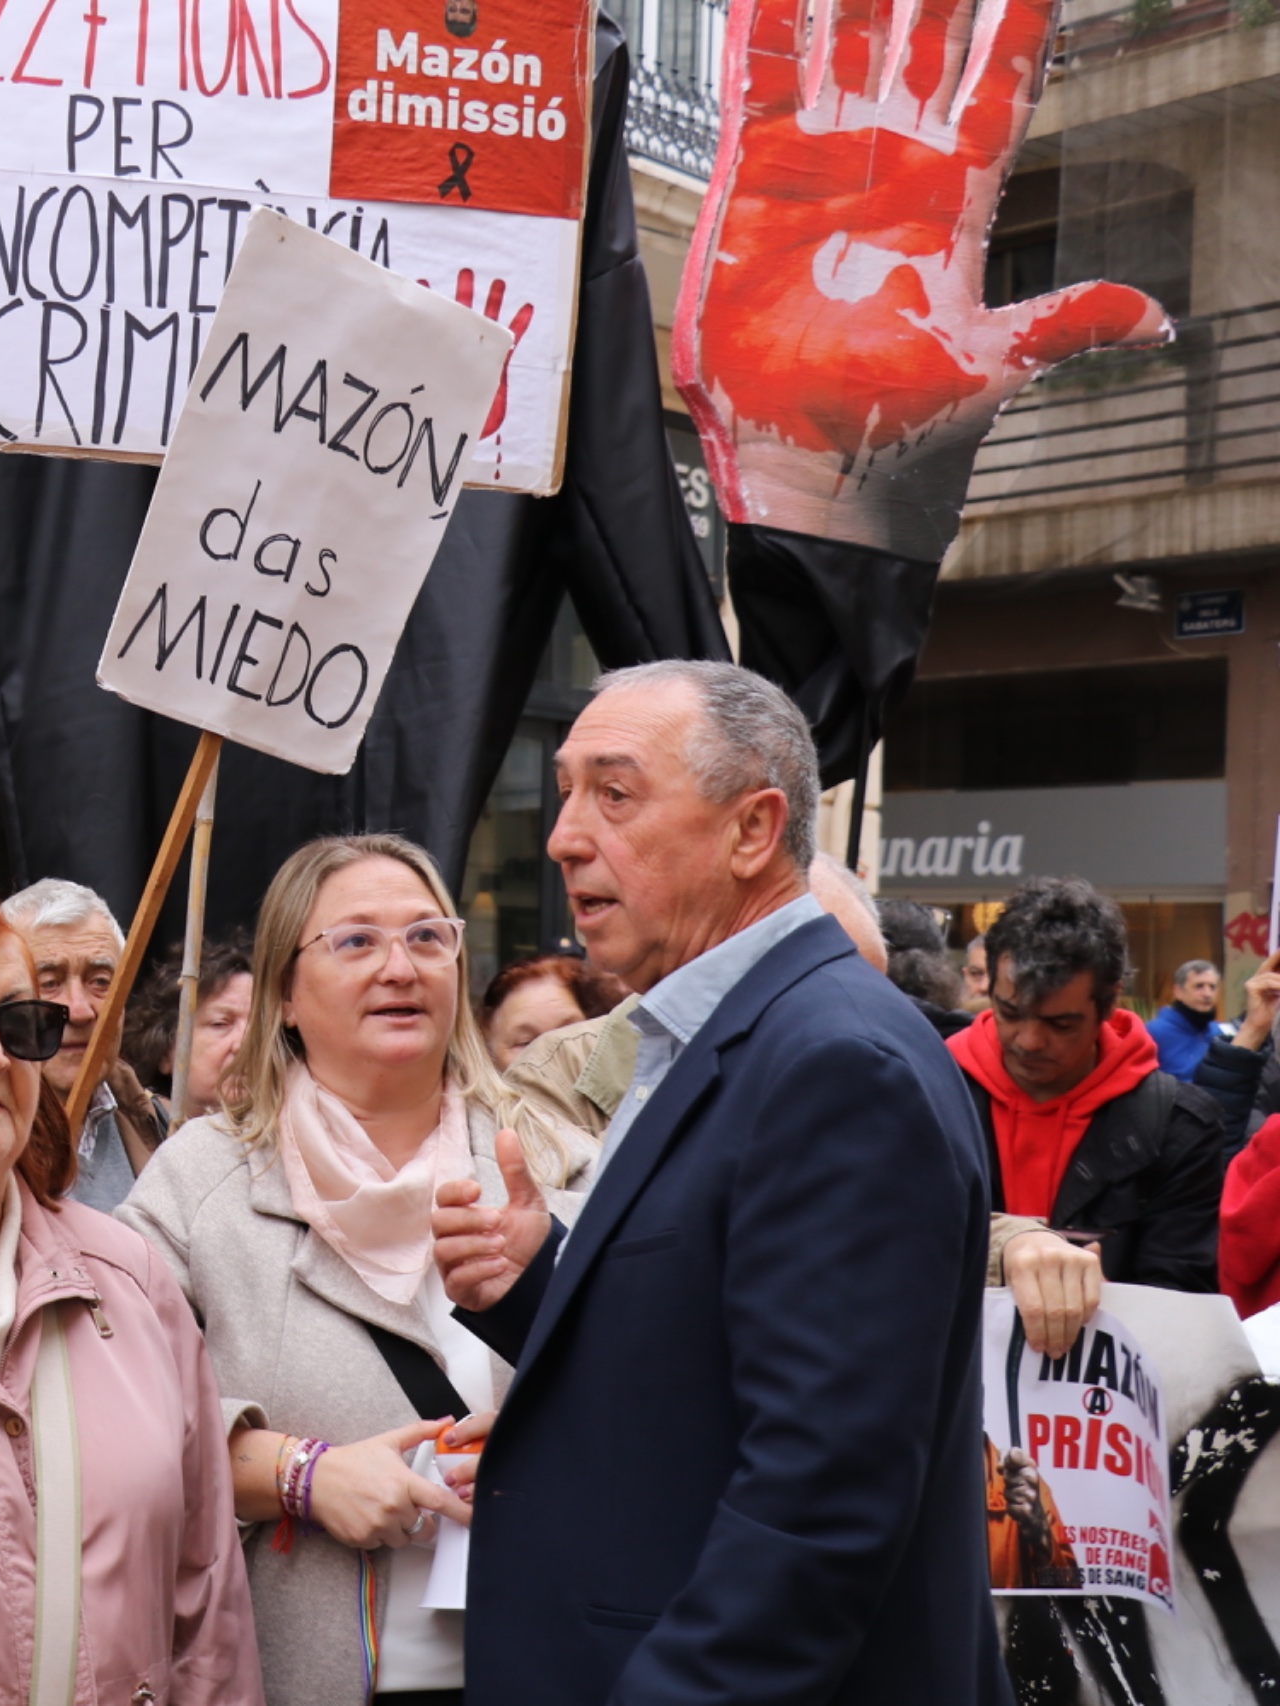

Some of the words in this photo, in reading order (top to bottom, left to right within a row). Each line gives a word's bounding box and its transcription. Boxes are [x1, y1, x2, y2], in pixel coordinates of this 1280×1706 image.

[376, 28, 543, 88] Mazón
[66, 94, 194, 180] PER
[347, 78, 567, 142] dimissió
[199, 332, 469, 507] MAZÓN
[199, 480, 337, 597] das
[118, 582, 369, 729] MIEDO
[1080, 1526, 1149, 1555] NOSTRES
[1086, 1547, 1101, 1565] DE
[1105, 1548, 1146, 1572] FANG
[1089, 1568, 1101, 1584] DE
[1105, 1568, 1146, 1591] SANG
